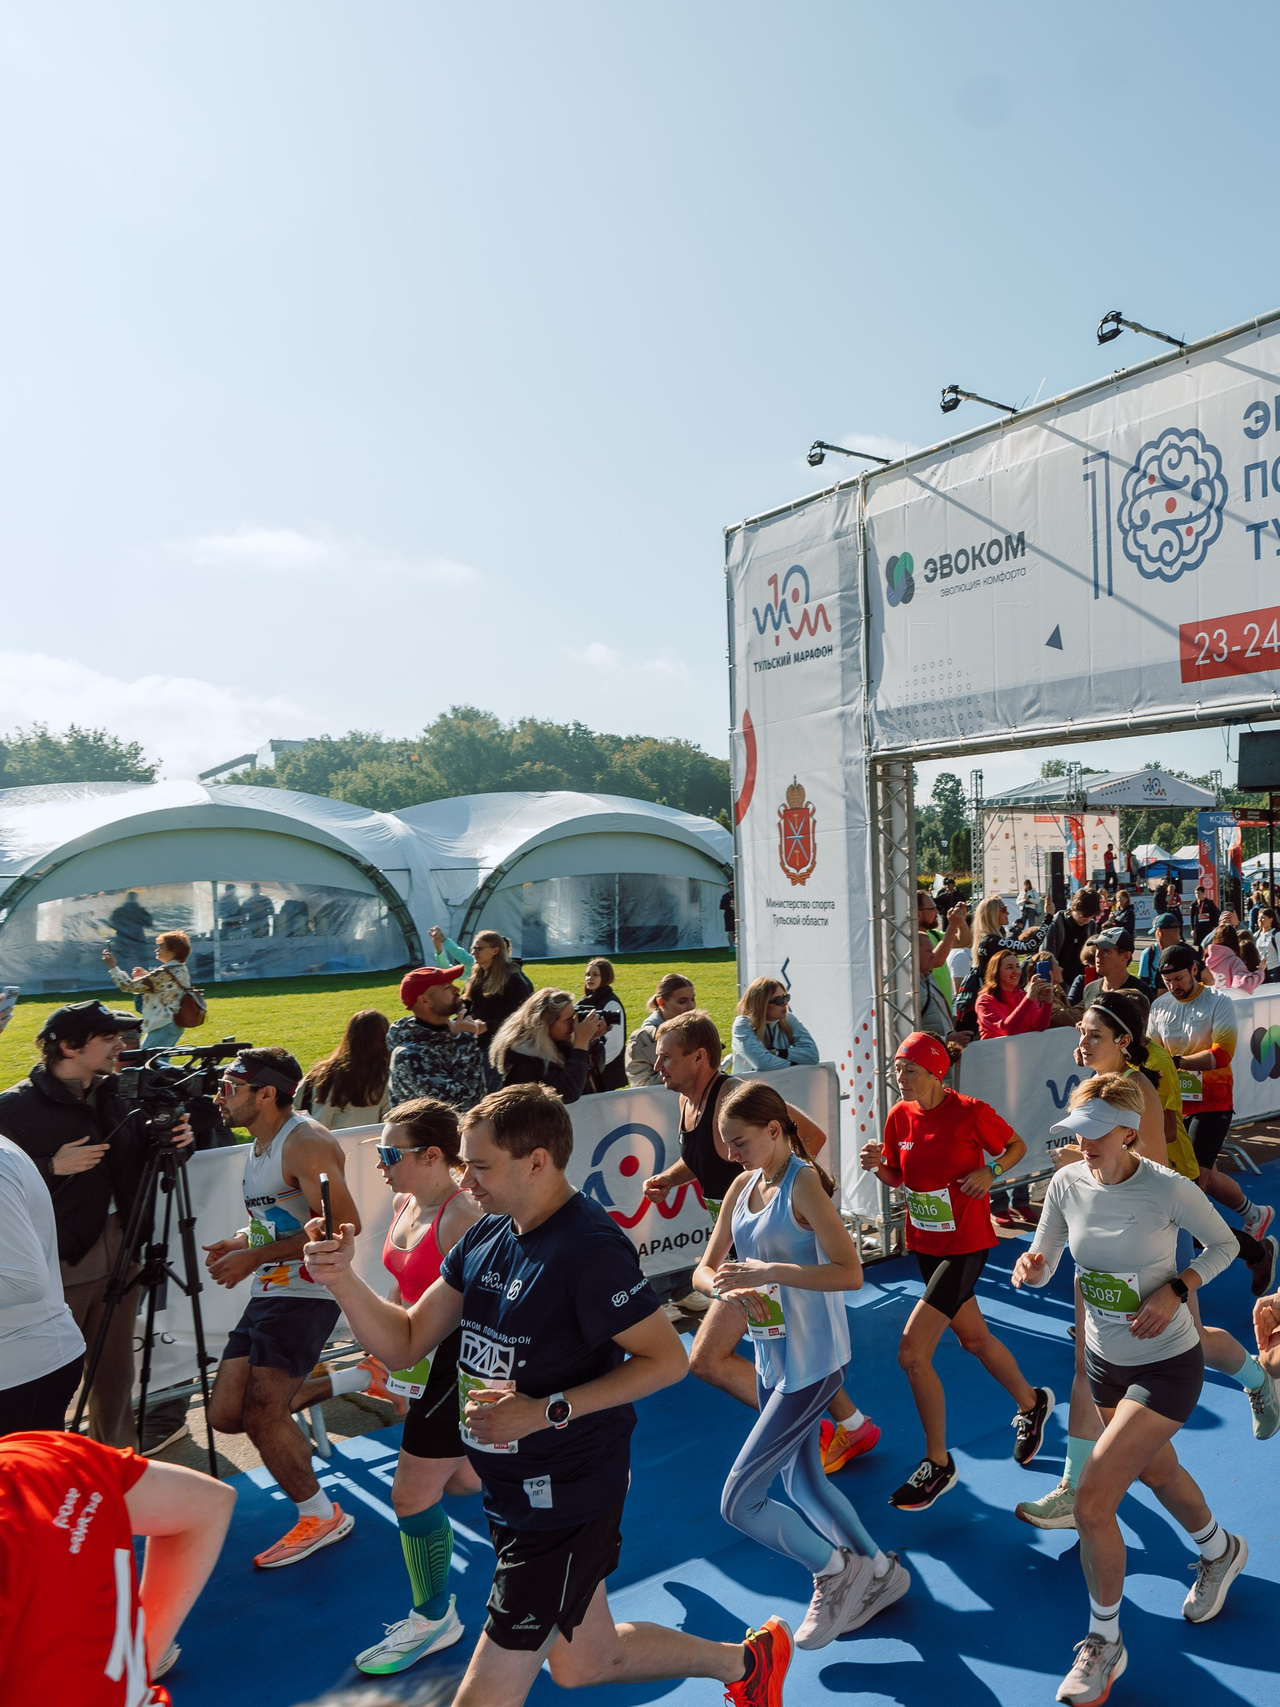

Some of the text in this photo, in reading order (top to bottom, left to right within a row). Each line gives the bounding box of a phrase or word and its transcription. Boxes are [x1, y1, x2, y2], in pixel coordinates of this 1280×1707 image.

[924, 531, 1027, 584] ЭВОКОМ
[939, 566, 1027, 598] эволюция комфорта
[753, 644, 834, 673] ТУЛЬСКИЙ МАРАФОН
[765, 898, 835, 911] Министерство спорта
[772, 914, 829, 927] Тульской области
[913, 1203, 938, 1216] 5016
[638, 1225, 716, 1257] АРАФОН
[1088, 1284, 1122, 1303] 5087
[460, 1319, 482, 1332] ОКОМ
[529, 1479, 546, 1489] 10
